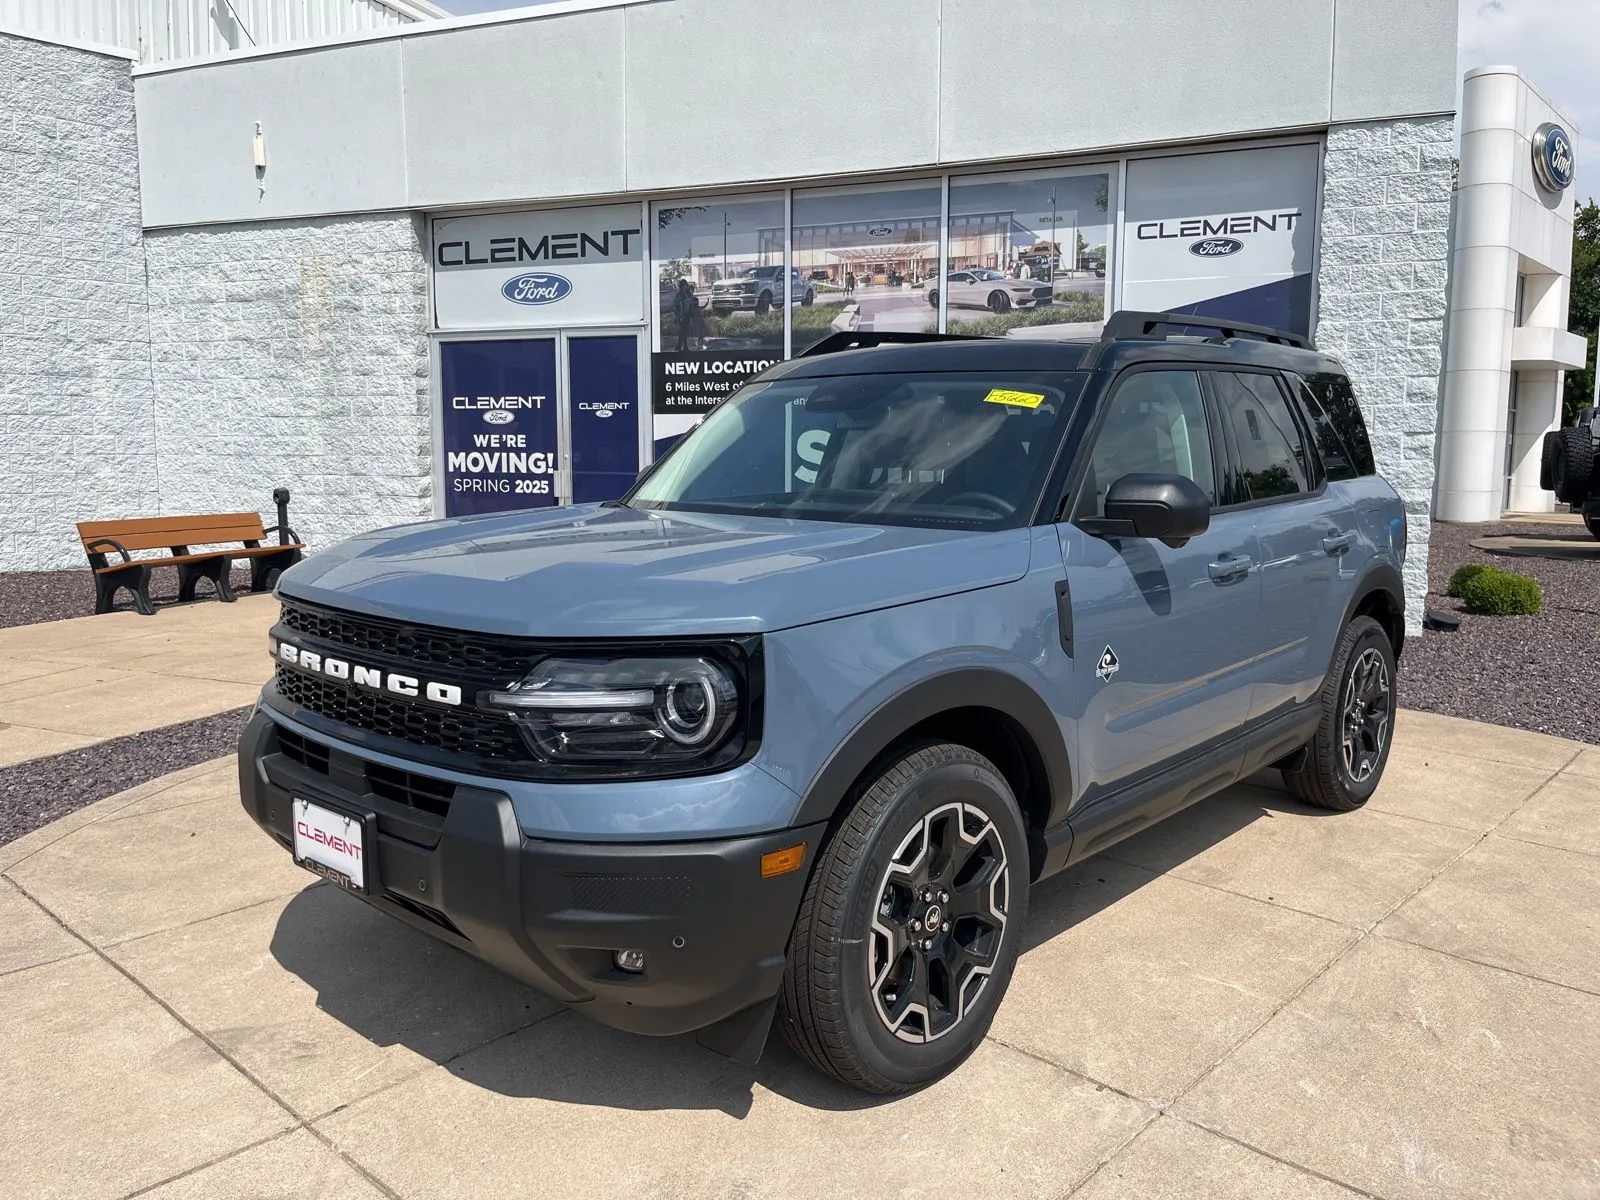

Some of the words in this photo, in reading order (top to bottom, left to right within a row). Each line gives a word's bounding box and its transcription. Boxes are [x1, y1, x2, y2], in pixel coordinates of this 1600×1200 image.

[1137, 212, 1302, 240] CLEMENT
[438, 229, 640, 266] CLEMENT
[665, 362, 699, 375] NEW
[665, 382, 672, 392] 6
[675, 381, 700, 392] Miles
[703, 381, 730, 392] West
[453, 396, 546, 410] CLEMENT
[578, 402, 630, 411] CLEMENT
[665, 396, 674, 405] at
[677, 395, 693, 405] the
[473, 434, 527, 448] WE'RE
[448, 452, 554, 474] MOVING!
[454, 478, 510, 493] SPRING
[515, 480, 549, 494] 2025
[280, 642, 462, 706] BRONCO
[297, 821, 362, 859] CLEMENT
[305, 859, 350, 888] CLEMENT
